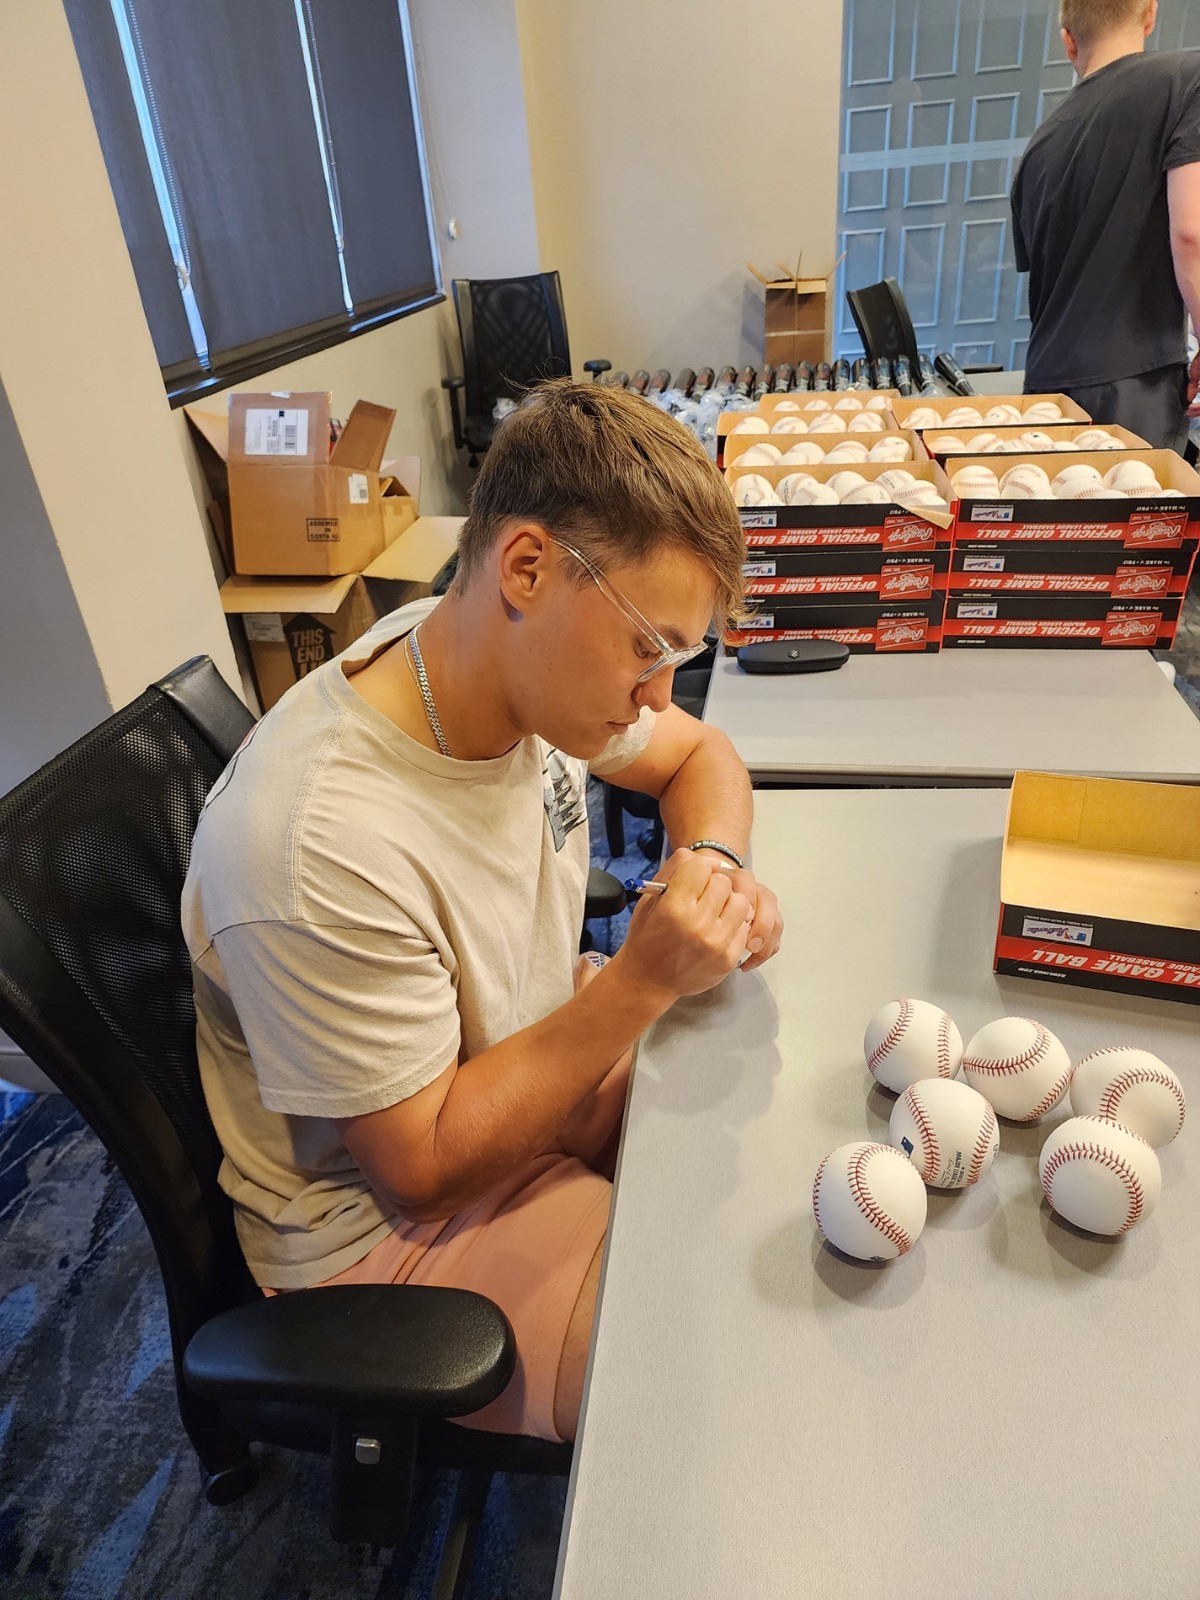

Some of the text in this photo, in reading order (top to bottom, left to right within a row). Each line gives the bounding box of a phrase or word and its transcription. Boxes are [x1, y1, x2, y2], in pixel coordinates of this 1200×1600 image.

[778, 535, 817, 543] GAME
[819, 533, 880, 542] OFFICIAL
[887, 528, 932, 543] Rawlings
[977, 529, 1122, 538] OFFICIAL GAME BALL
[1131, 525, 1181, 540] Rawlings
[777, 583, 815, 592] GAME
[817, 581, 877, 590] OFFICIAL
[885, 576, 929, 591] Rawlings
[968, 579, 1109, 590] OFFICIAL GAME BALL
[1117, 578, 1165, 592] Rawlings
[880, 629, 924, 643] Rawlings
[963, 625, 1100, 635] OFFICIAL GAME BALL
[1108, 623, 1155, 637] Rawlings
[292, 628, 324, 647] THIS
[297, 645, 325, 663] END
[1027, 928, 1068, 936] Authentic
[1032, 950, 1088, 967] BALL
[1108, 954, 1200, 973] AGUE BASEBALL
[1091, 960, 1165, 978] GAME
